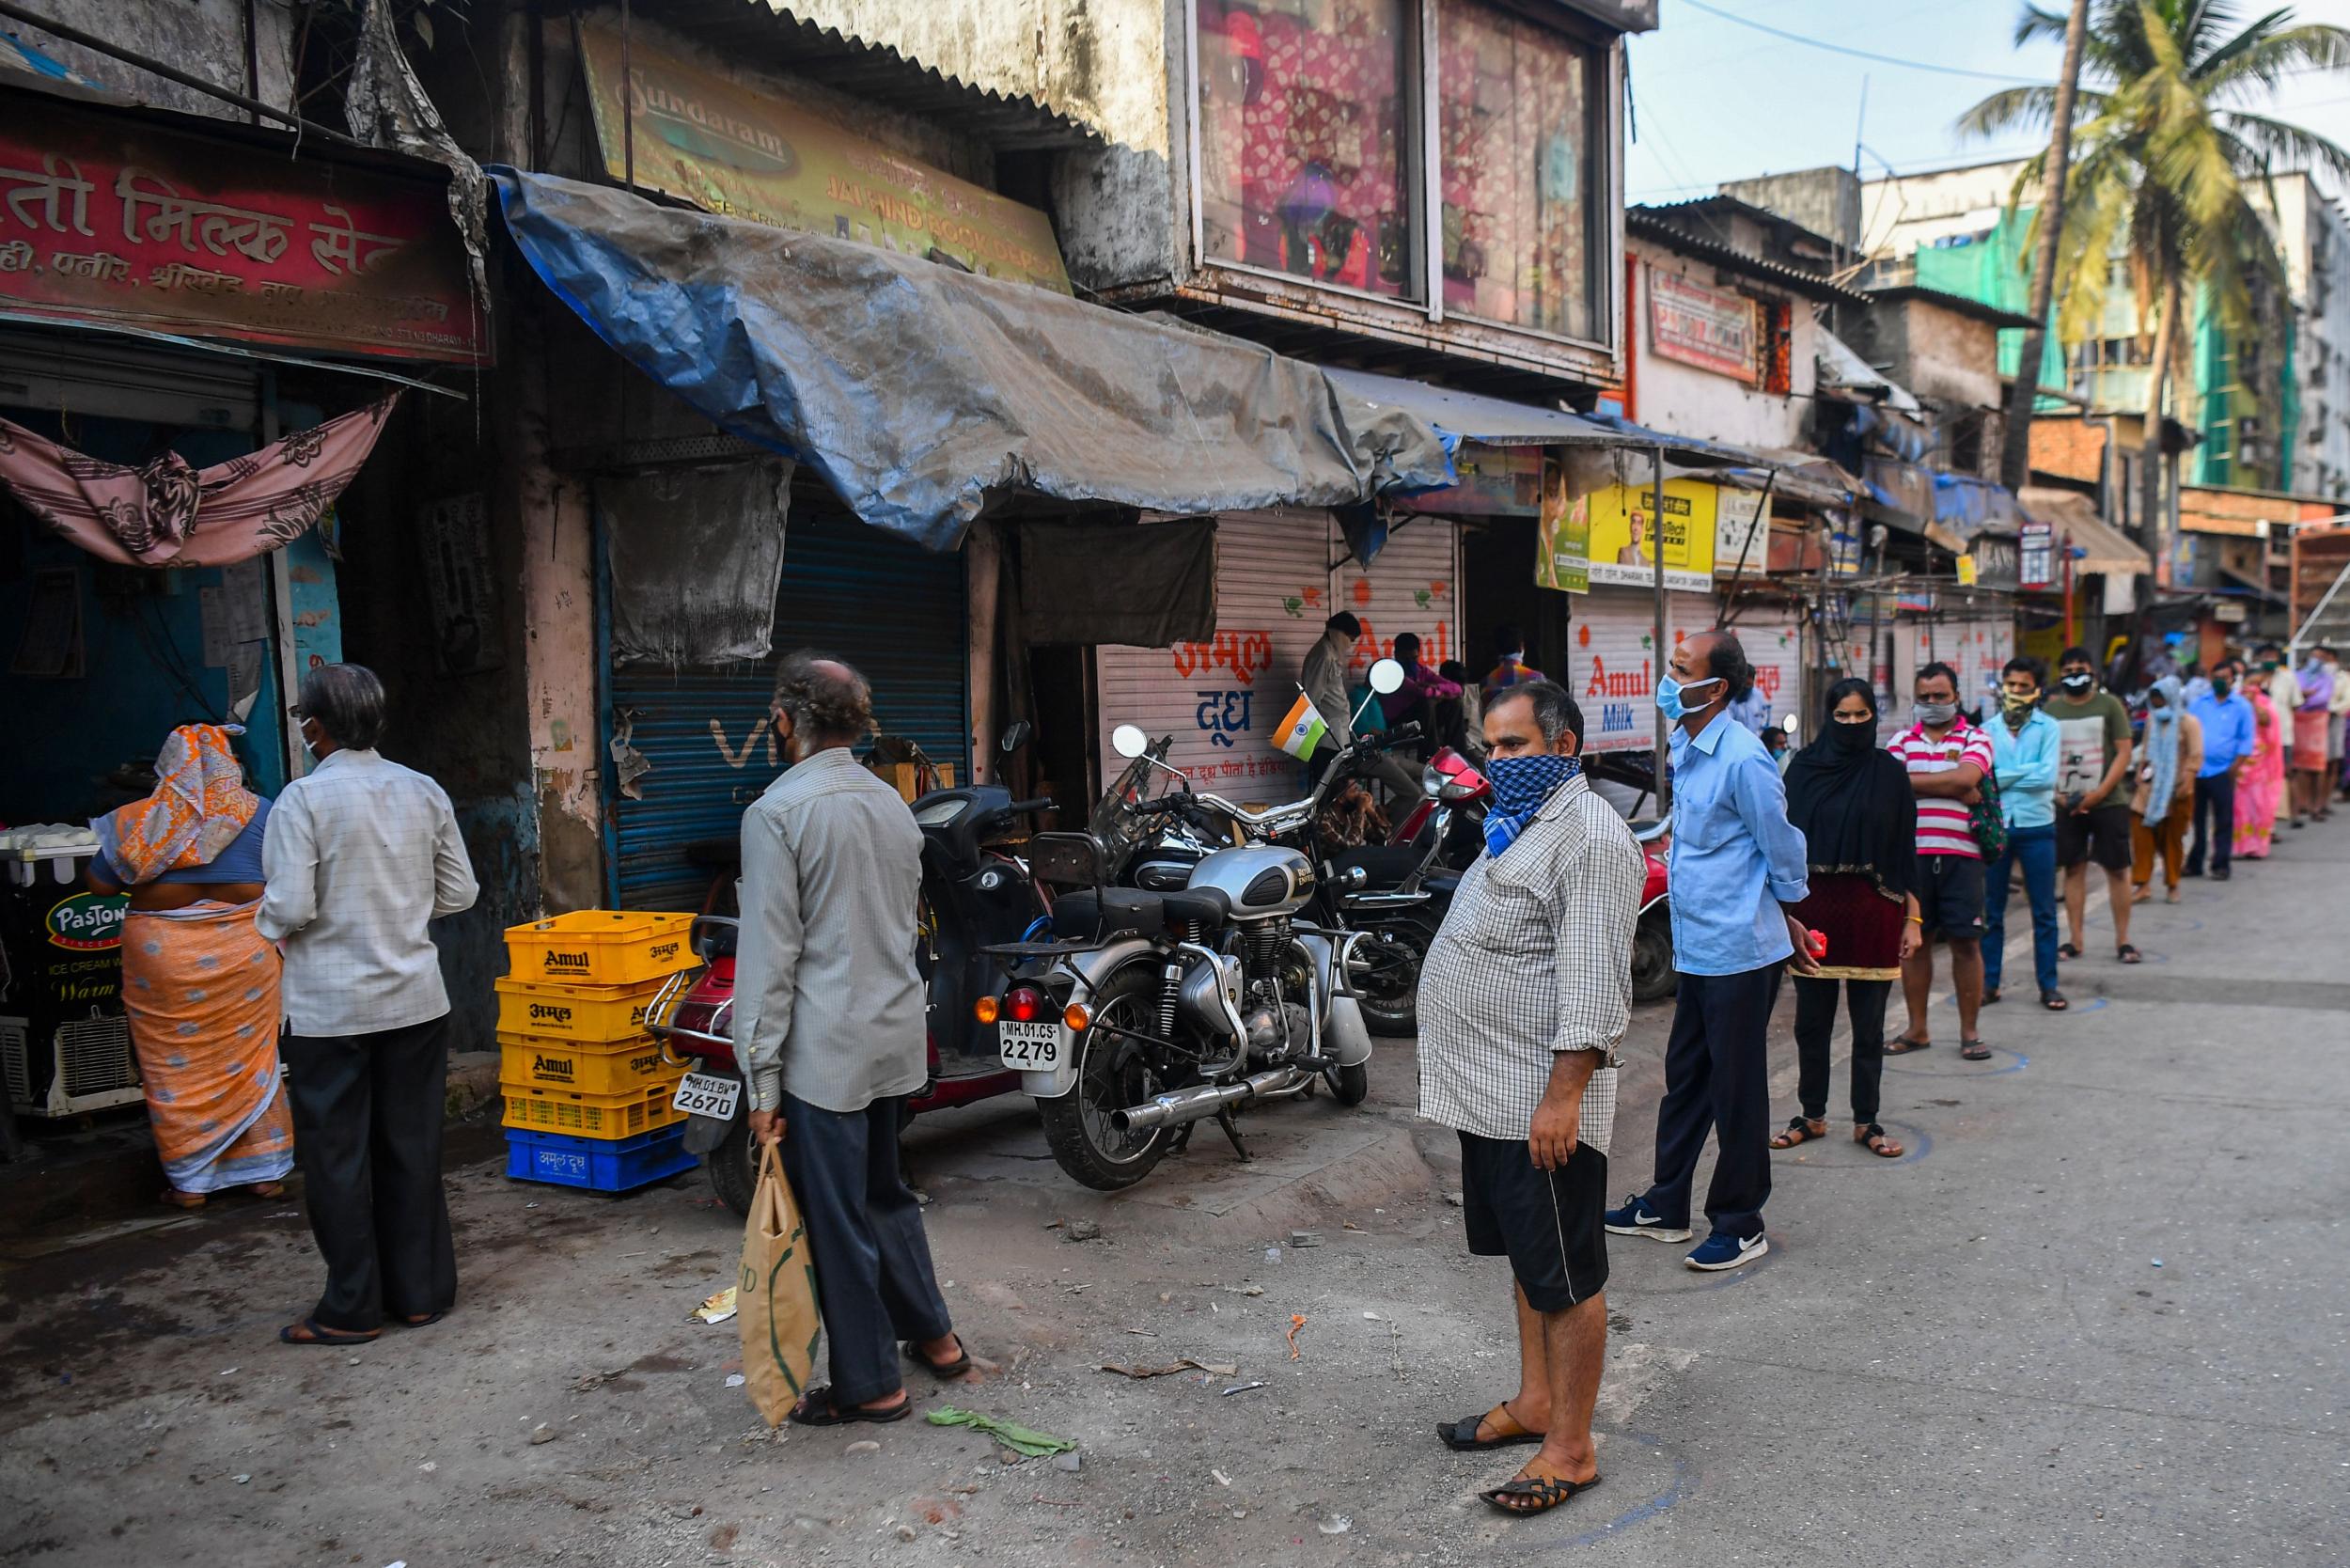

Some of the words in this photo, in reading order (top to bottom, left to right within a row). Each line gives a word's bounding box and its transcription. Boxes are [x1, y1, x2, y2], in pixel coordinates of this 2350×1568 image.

[616, 69, 784, 158] Sundaram
[0, 150, 95, 237] ती
[116, 165, 294, 263] मिल्क
[825, 175, 862, 207] JAI
[865, 186, 924, 230] HIND
[927, 212, 988, 256] BOOK
[0, 240, 44, 277] ही,
[1587, 654, 1651, 698] Amul
[1197, 691, 1255, 748] दूध
[1602, 702, 1635, 732] Milk
[61, 937, 104, 949] SINCE
[650, 942, 679, 958] अमूल
[49, 963, 68, 975] ICE
[70, 959, 111, 973] CREAM
[544, 950, 590, 967] Amul
[51, 977, 115, 1002] Warm
[529, 1003, 572, 1022] अमूल
[1007, 1023, 1053, 1039] MH.01.CS
[1003, 1039, 1057, 1062] 2279
[533, 1054, 573, 1074] Amul
[688, 1077, 731, 1095] MH.01.BW
[678, 1090, 732, 1115] 2670
[540, 1151, 566, 1171] अमूल
